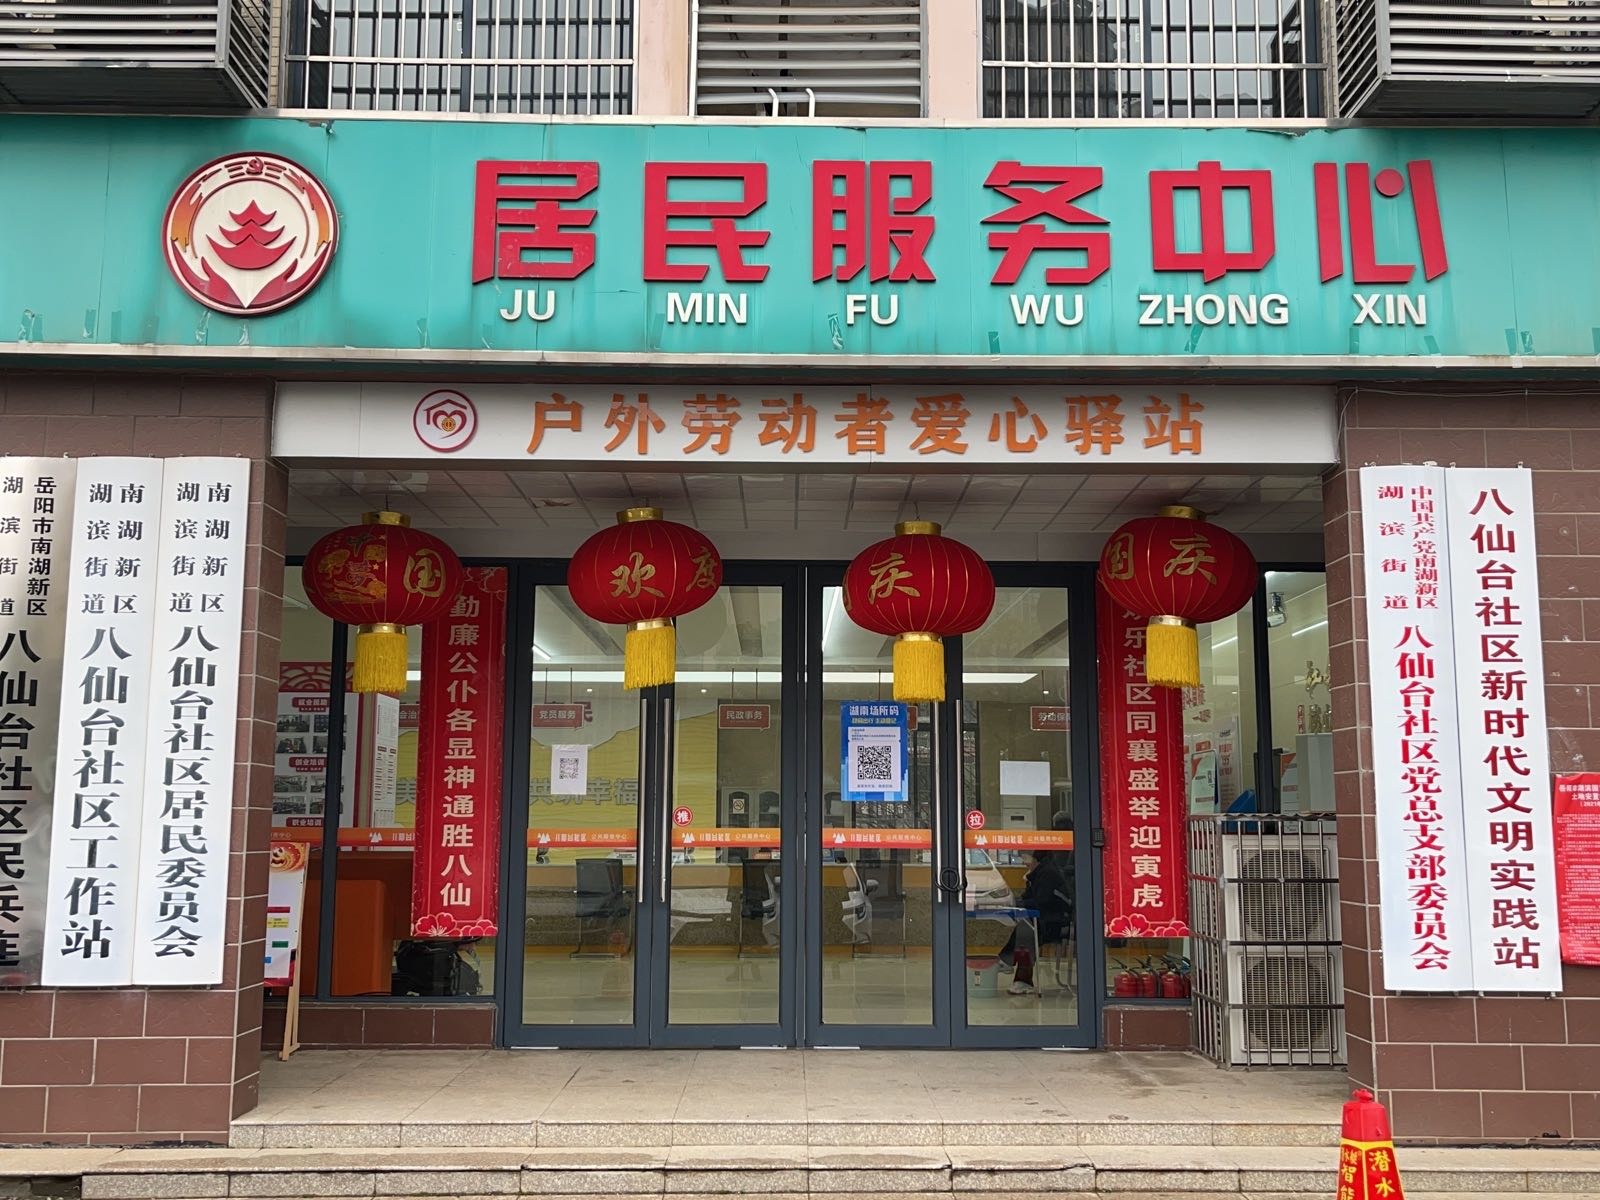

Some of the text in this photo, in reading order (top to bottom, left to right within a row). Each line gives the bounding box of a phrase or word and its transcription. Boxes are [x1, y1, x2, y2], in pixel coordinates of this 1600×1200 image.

[473, 160, 1449, 284] 居民服务中心
[499, 289, 1427, 326] JU MIN FU WU ZHONG XIN
[527, 392, 1204, 456] 户外劳动者爱心驿站
[26, 477, 57, 616] 岳阳市南湖新区
[82, 483, 113, 614] 湖滨街道
[113, 483, 145, 614] 南湖新区
[169, 482, 200, 614] 湖滨街道
[200, 482, 232, 614] 南湖新区
[1377, 485, 1409, 610] 湖滨街道
[1411, 485, 1439, 610] 中国共产党南湖新区
[440, 595, 480, 907] 勤廉公仆各显神通胜八仙
[726, 710, 763, 720] 民政事务
[849, 705, 899, 716] 湖南场所码
[1122, 609, 1164, 908] 乐社区同襄盛举迎寅虎
[1469, 488, 1541, 970] 八仙台社区新时代文明实践站
[61, 627, 132, 960] 八仙台社区工作站
[149, 625, 219, 959] 八仙台社区居民委员会
[529, 777, 638, 806] 共幸福
[676, 810, 690, 823] 推
[968, 812, 983, 827] 拉
[1394, 625, 1451, 971] 八仙台社区党总支部委员会
